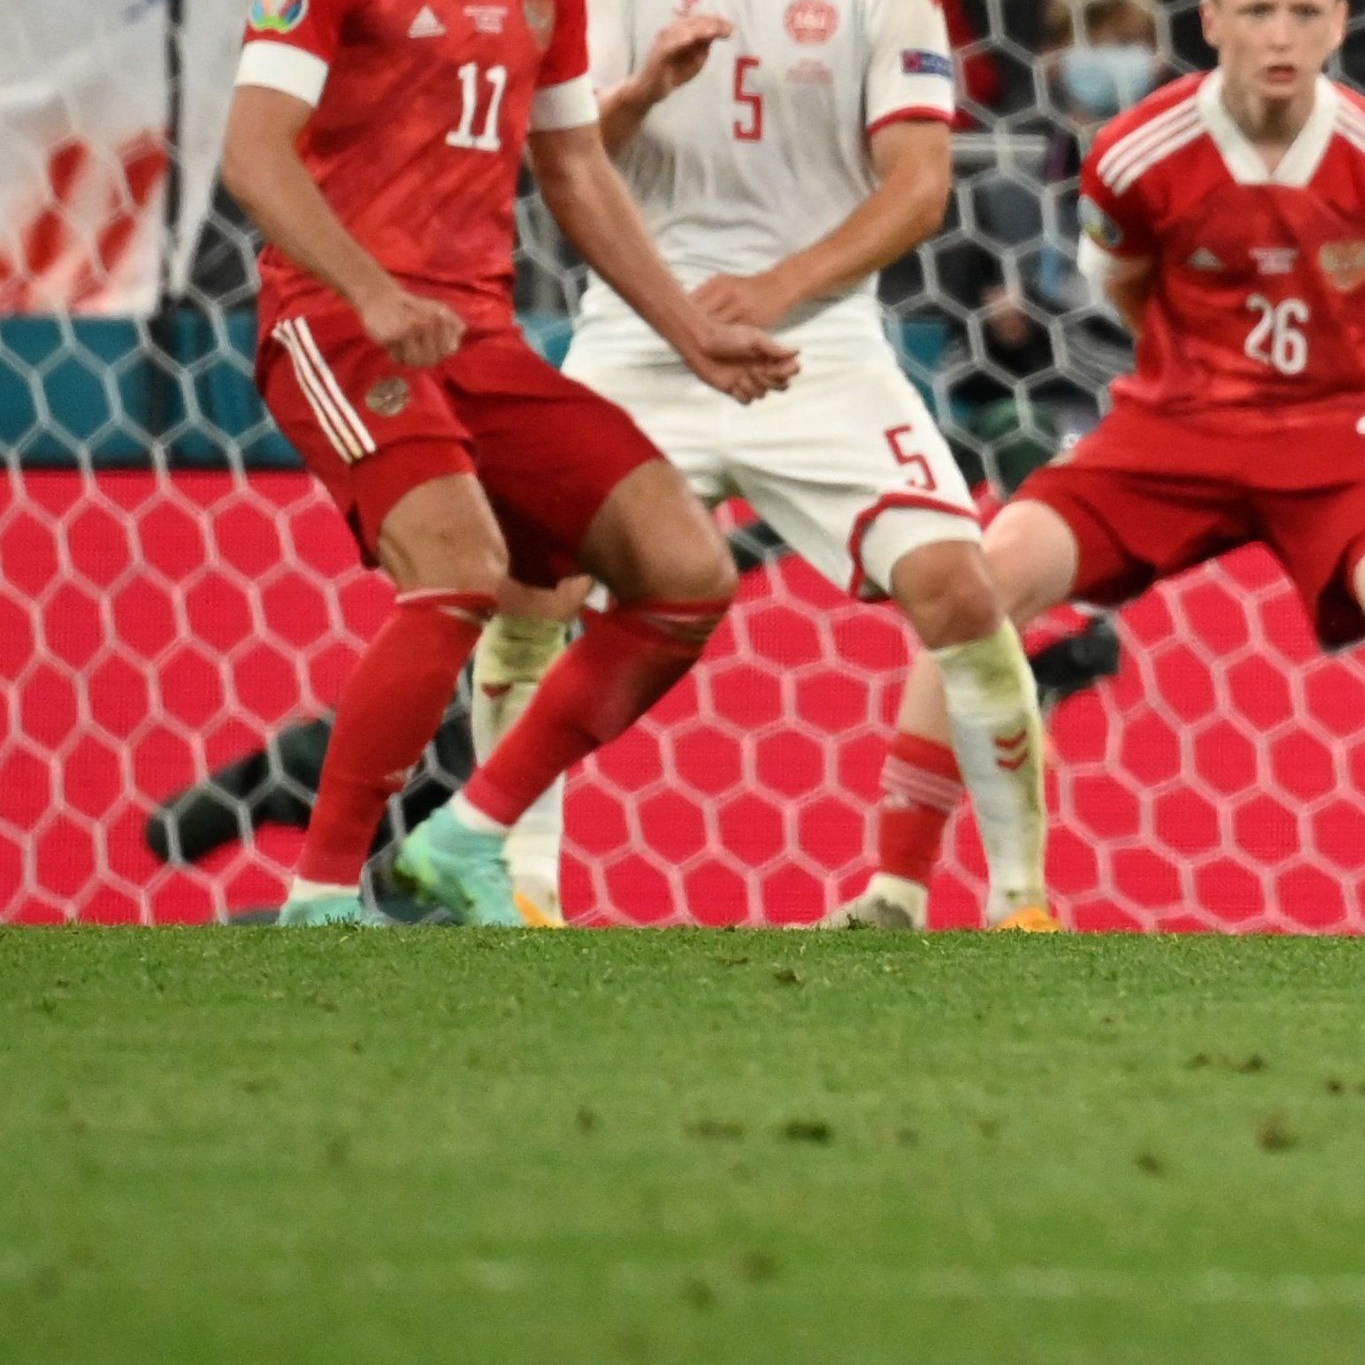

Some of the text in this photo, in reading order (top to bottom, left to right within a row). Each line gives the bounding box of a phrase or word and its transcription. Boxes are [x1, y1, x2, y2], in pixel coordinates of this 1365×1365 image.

[445, 62, 507, 152] 11
[733, 55, 763, 141] 5
[1244, 293, 1309, 375] 26
[884, 425, 936, 492] 5
